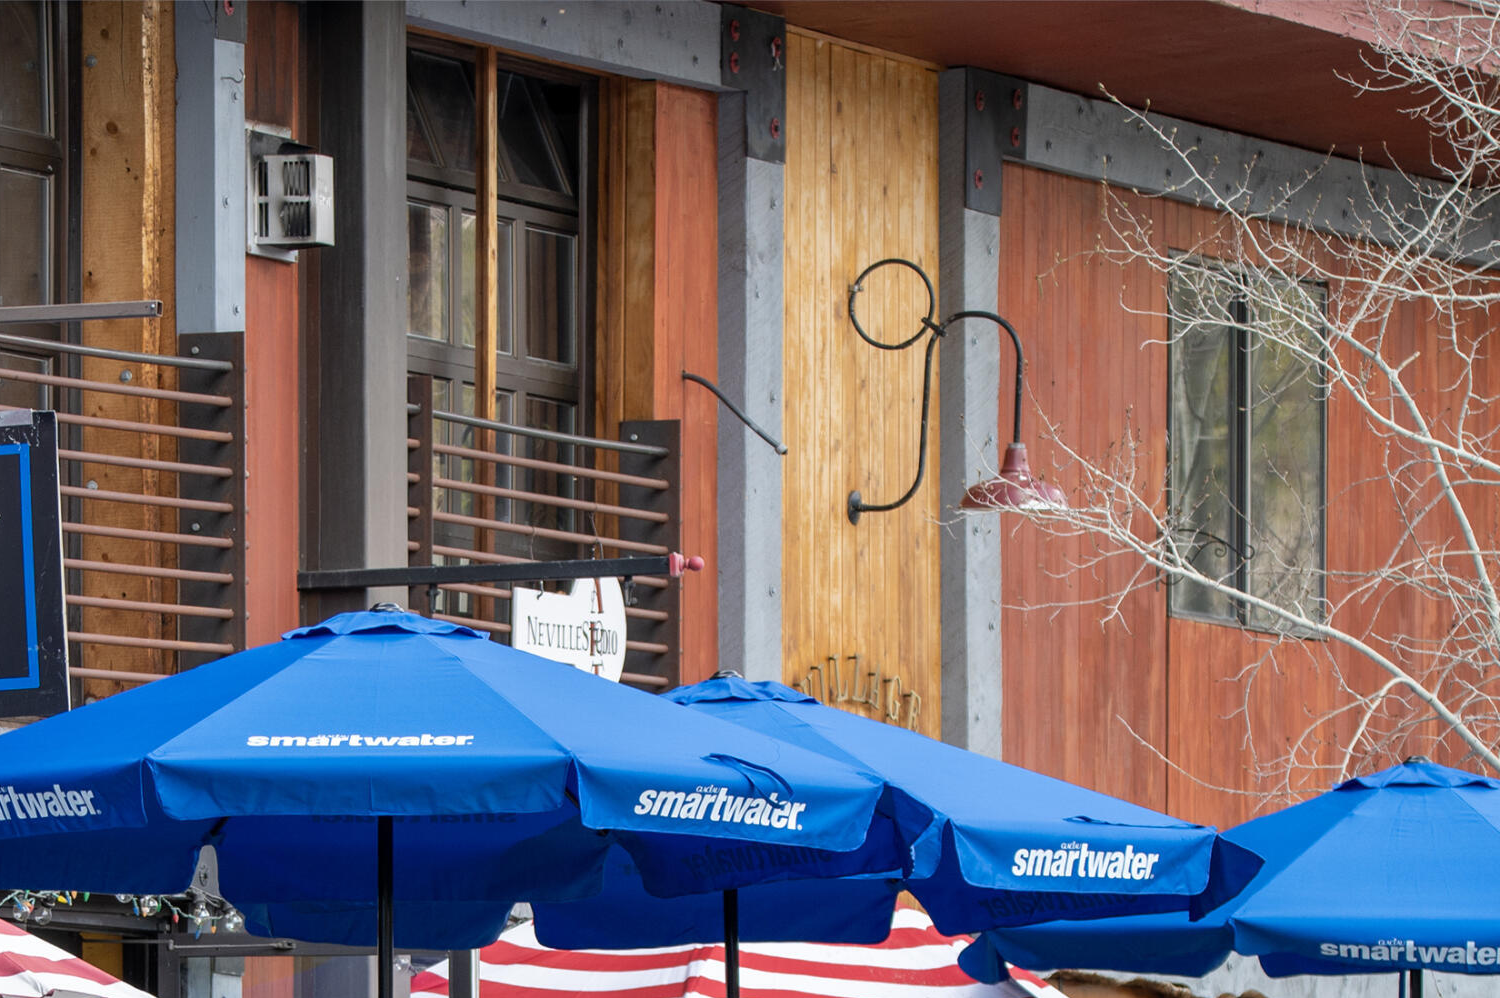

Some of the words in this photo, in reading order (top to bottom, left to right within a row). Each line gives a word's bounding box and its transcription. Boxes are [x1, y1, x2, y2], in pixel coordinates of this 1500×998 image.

[245, 733, 474, 747] smartwater
[633, 787, 807, 831] smartwater
[1011, 843, 1160, 880] smartwater
